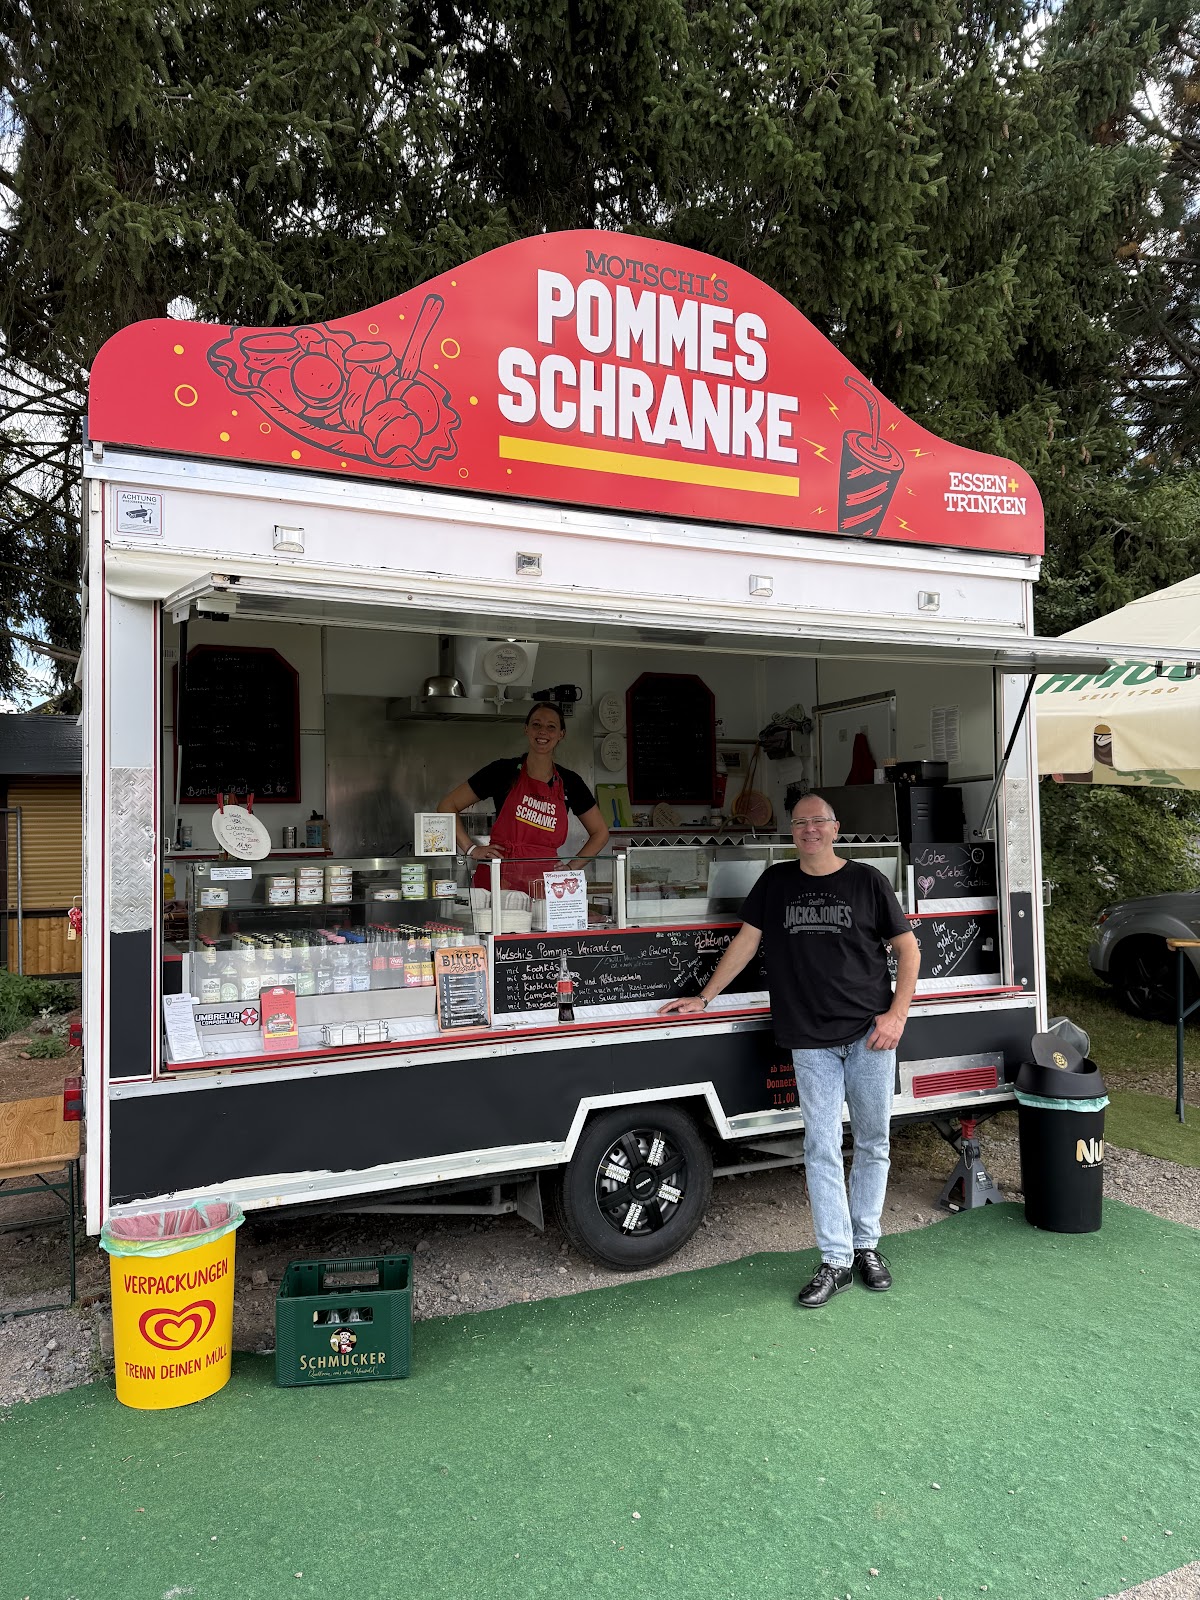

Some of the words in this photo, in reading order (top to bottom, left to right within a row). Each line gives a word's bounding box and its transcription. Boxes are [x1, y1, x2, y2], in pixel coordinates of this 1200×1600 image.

[585, 249, 729, 302] MOTSCHI'S
[537, 268, 769, 384] POMMES
[497, 346, 800, 465] SCHRANKE
[121, 493, 157, 503] ACHTUNG
[943, 492, 1027, 516] TRINKEN
[1078, 691, 1119, 702] SEIT
[1127, 686, 1180, 698] 1780
[521, 794, 557, 816] POMMES
[515, 804, 558, 829] SCHRANKE
[782, 905, 853, 929] JACK&JONES
[932, 921, 947, 937] Hier
[536, 941, 574, 958] Pommes
[577, 940, 625, 955] Varianten
[944, 950, 957, 966] die
[194, 1011, 241, 1023] UMBRELLA
[200, 1018, 241, 1027] CORPORATION
[773, 1092, 796, 1105] 11.00
[123, 1257, 228, 1295] VERPACKUNGEN
[124, 1361, 156, 1380] TRENN
[160, 1357, 202, 1380] DEINEN
[205, 1343, 228, 1368] MÜLL
[299, 1351, 387, 1371] SCHMUCKER
